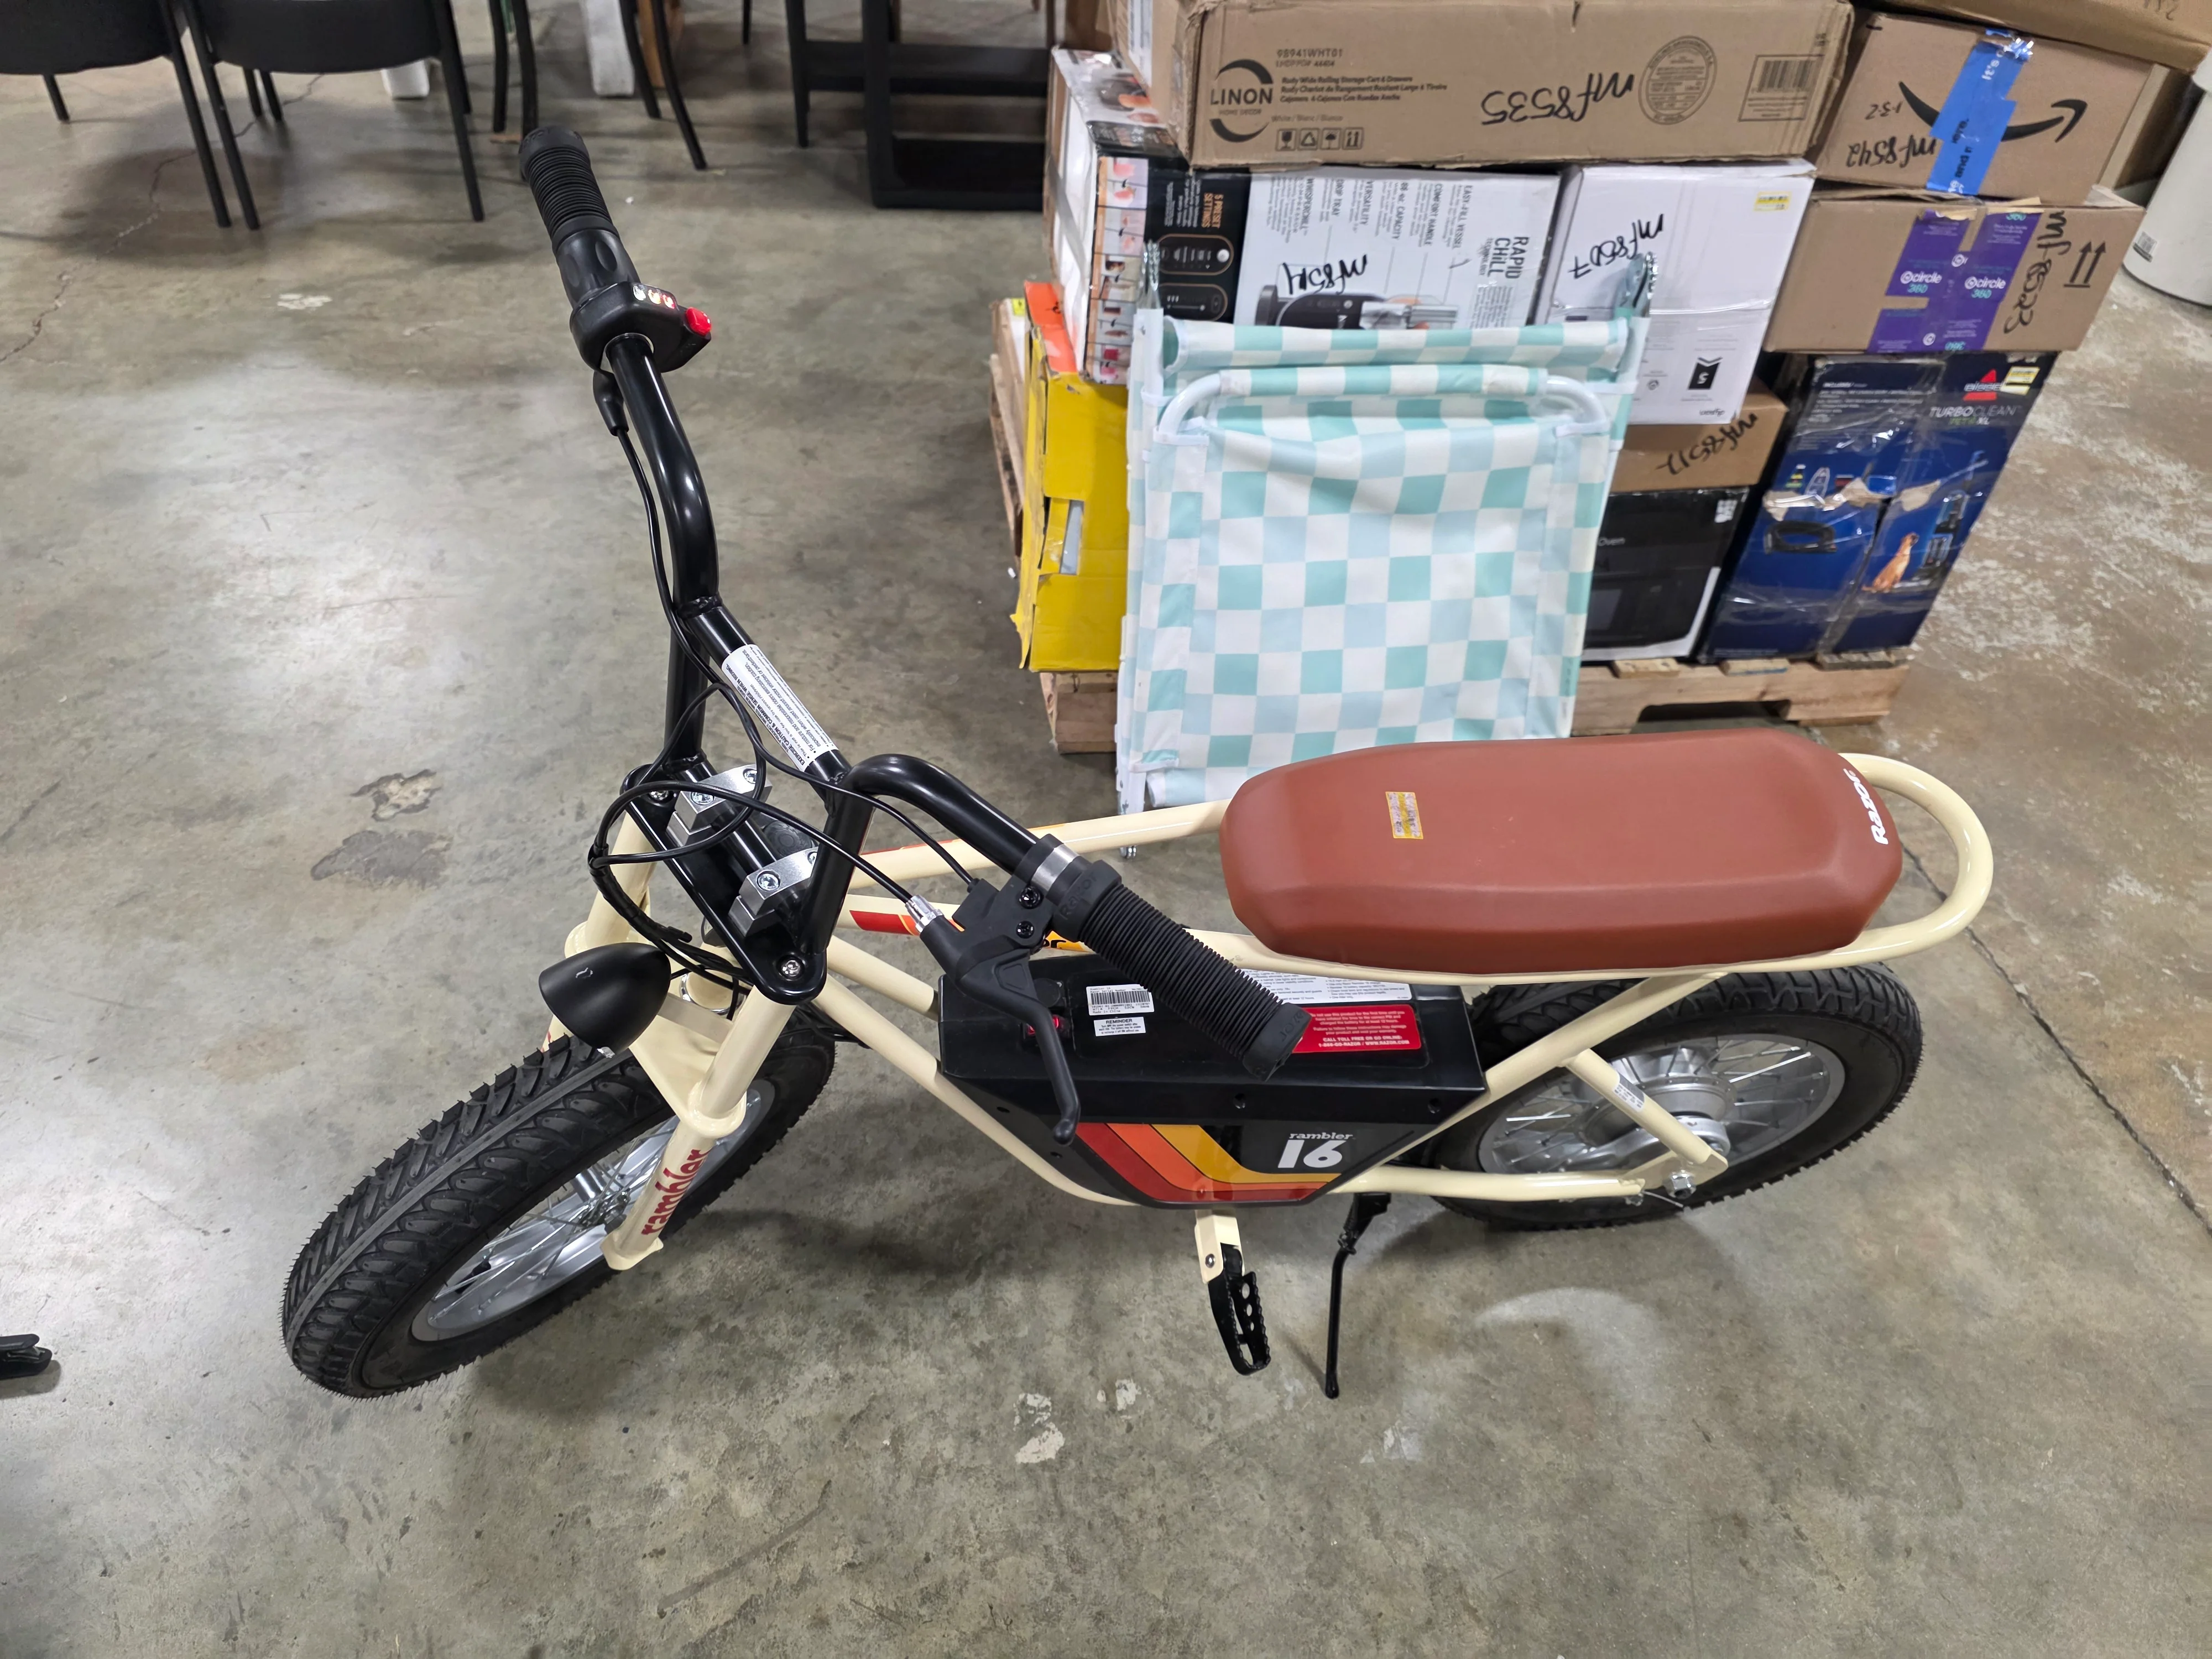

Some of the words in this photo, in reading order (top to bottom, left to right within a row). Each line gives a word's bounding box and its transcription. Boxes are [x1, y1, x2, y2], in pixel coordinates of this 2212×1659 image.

[1210, 88, 1272, 105] LINON
[1505, 237, 1530, 279] RAPID
[1907, 284, 1928, 293] 360
[1971, 289, 1992, 299] 360
[742, 649, 760, 671] pedestrians.
[724, 664, 739, 681] RIDING.
[736, 679, 748, 693] WHEN
[771, 687, 782, 700] motor
[745, 691, 759, 706] SENSE
[768, 693, 779, 705] riders
[756, 704, 773, 724] COMMON
[776, 704, 794, 725] responsible
[790, 710, 800, 721] used
[792, 723, 800, 732] and
[797, 719, 807, 731] when
[774, 727, 790, 745] CAUTION
[797, 731, 810, 745] mature
[805, 729, 821, 748] especially
[787, 744, 806, 765] EXERCISE
[1843, 768, 1888, 844] Razor
[1278, 1140, 1347, 1168] 16
[641, 1146, 713, 1235] rambler
